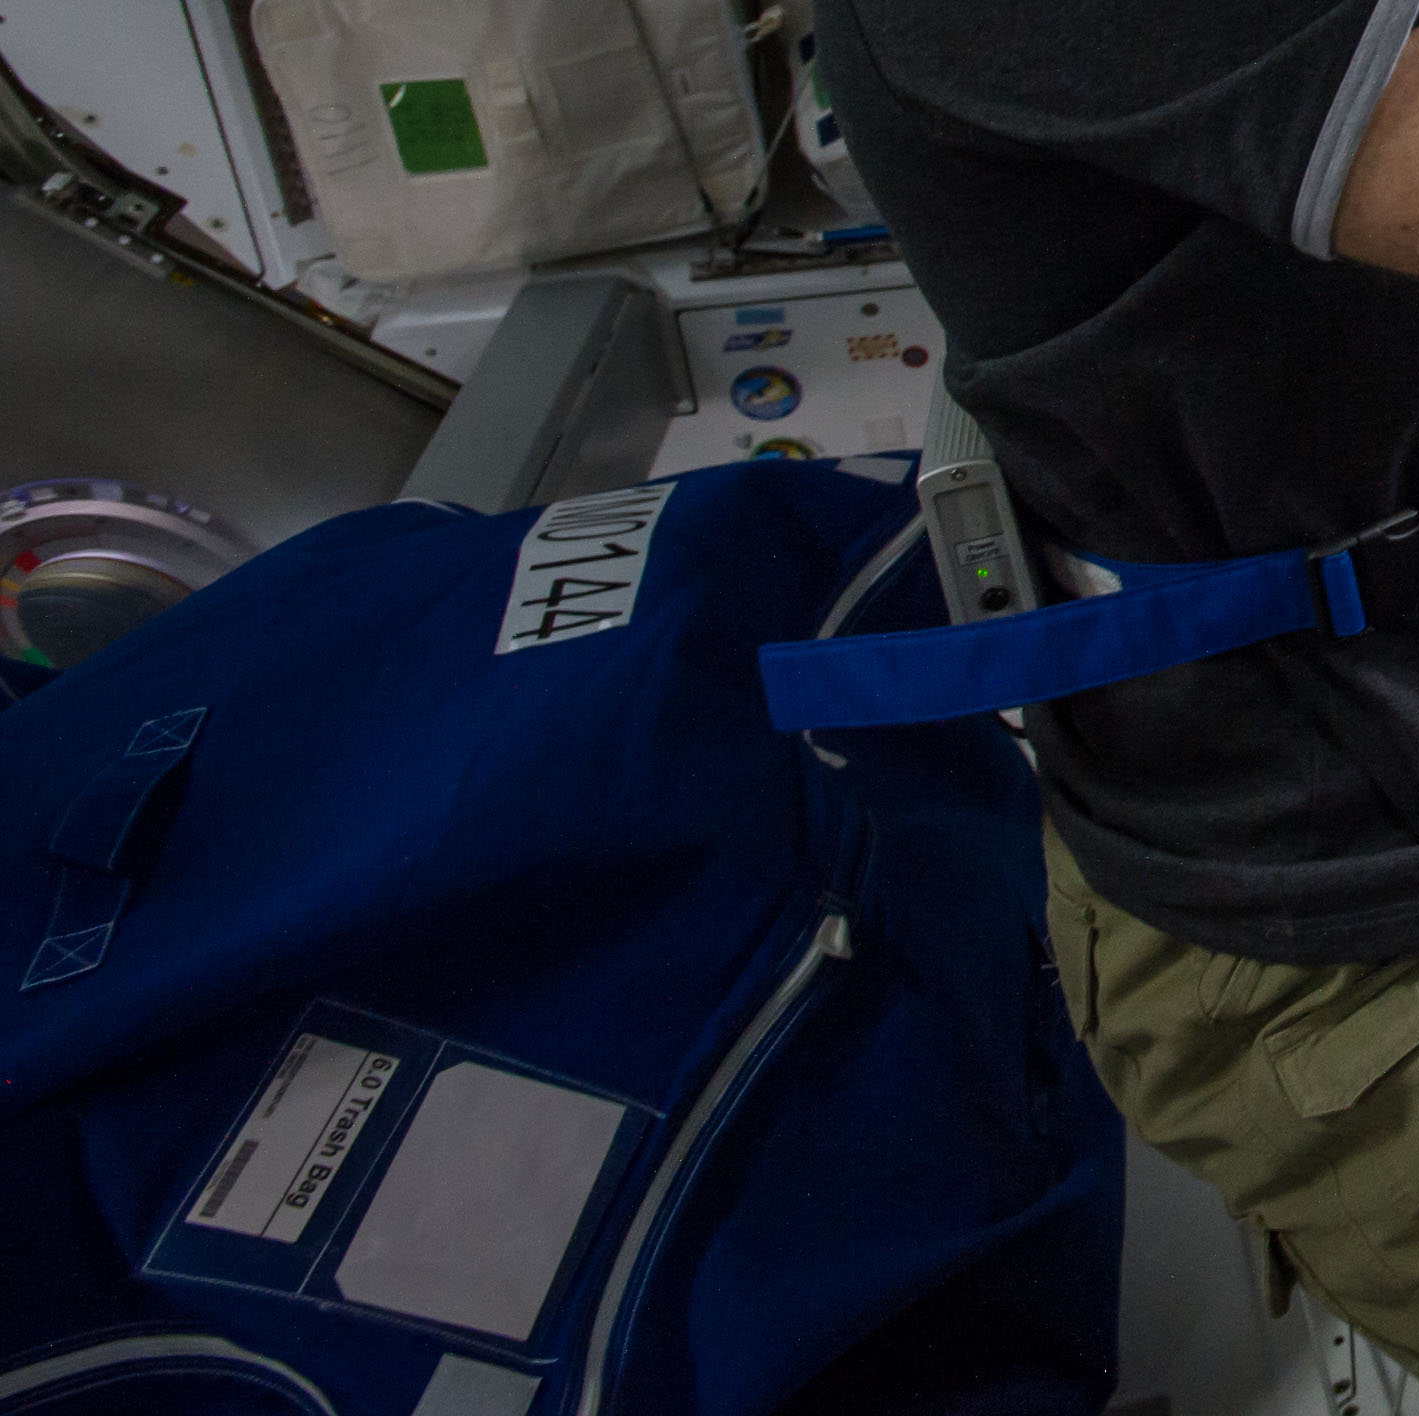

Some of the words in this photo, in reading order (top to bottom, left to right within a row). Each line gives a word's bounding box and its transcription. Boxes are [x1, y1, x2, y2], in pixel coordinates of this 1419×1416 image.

[360, 1058, 393, 1091] 6.0
[320, 1096, 373, 1159] Trash
[285, 1163, 333, 1210] Bag
